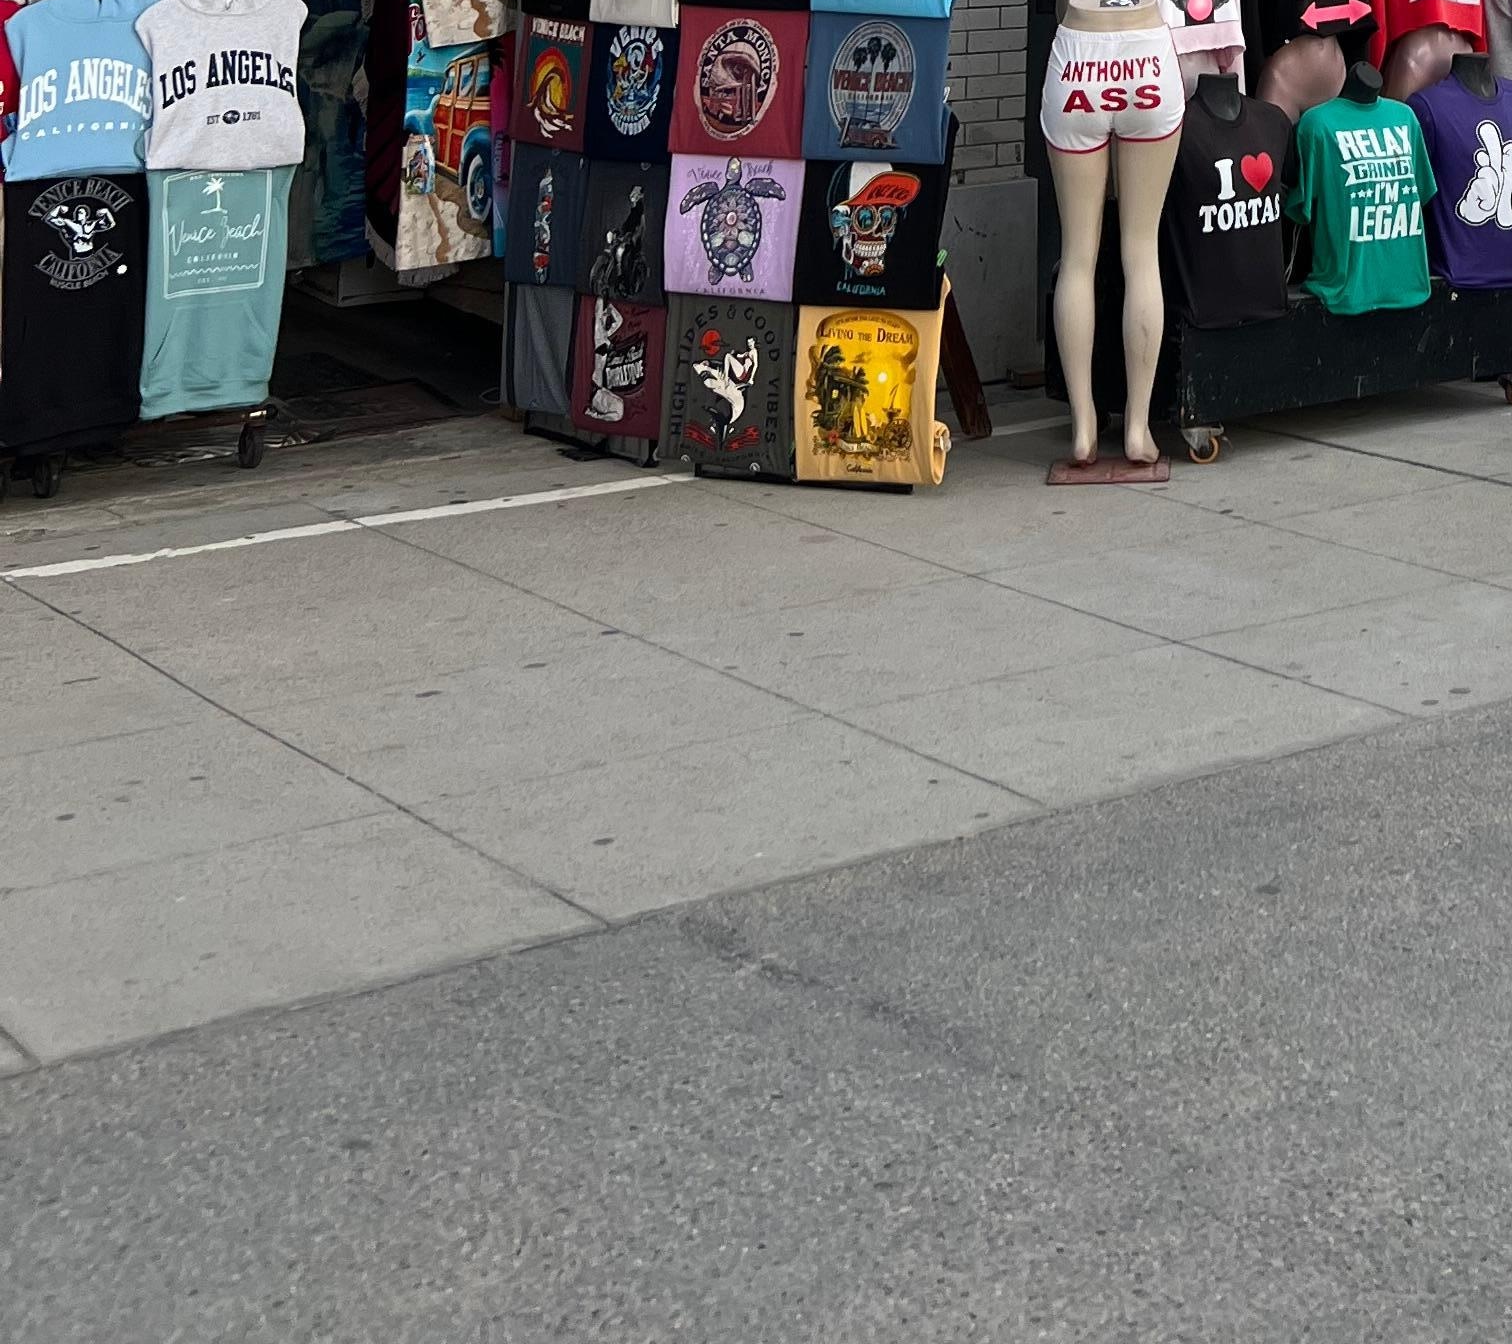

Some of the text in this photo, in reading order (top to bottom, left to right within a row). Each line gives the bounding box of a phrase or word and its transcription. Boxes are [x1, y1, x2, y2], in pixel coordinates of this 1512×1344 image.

[702, 30, 772, 93] SANTA MONICA
[1061, 56, 1160, 82] ANTHONY'S
[19, 68, 58, 129] LOS
[160, 60, 196, 110] LOS
[1063, 85, 1161, 113] ASS
[207, 115, 220, 126] EST
[1336, 125, 1412, 161] RELAX
[1215, 158, 1236, 200] I
[1357, 159, 1415, 180] GRING
[28, 176, 134, 218] VENICE BEACH
[1374, 181, 1399, 204] I'M
[169, 213, 265, 255] Venice Beach
[1350, 201, 1422, 242] LEGAL
[677, 305, 719, 367] TIDES
[743, 306, 779, 362] GOOD
[820, 320, 853, 340] LIVING
[858, 331, 872, 342] THE
[876, 327, 913, 344] DREAM
[671, 382, 687, 436] HIGH
[765, 378, 779, 444] VIBES
